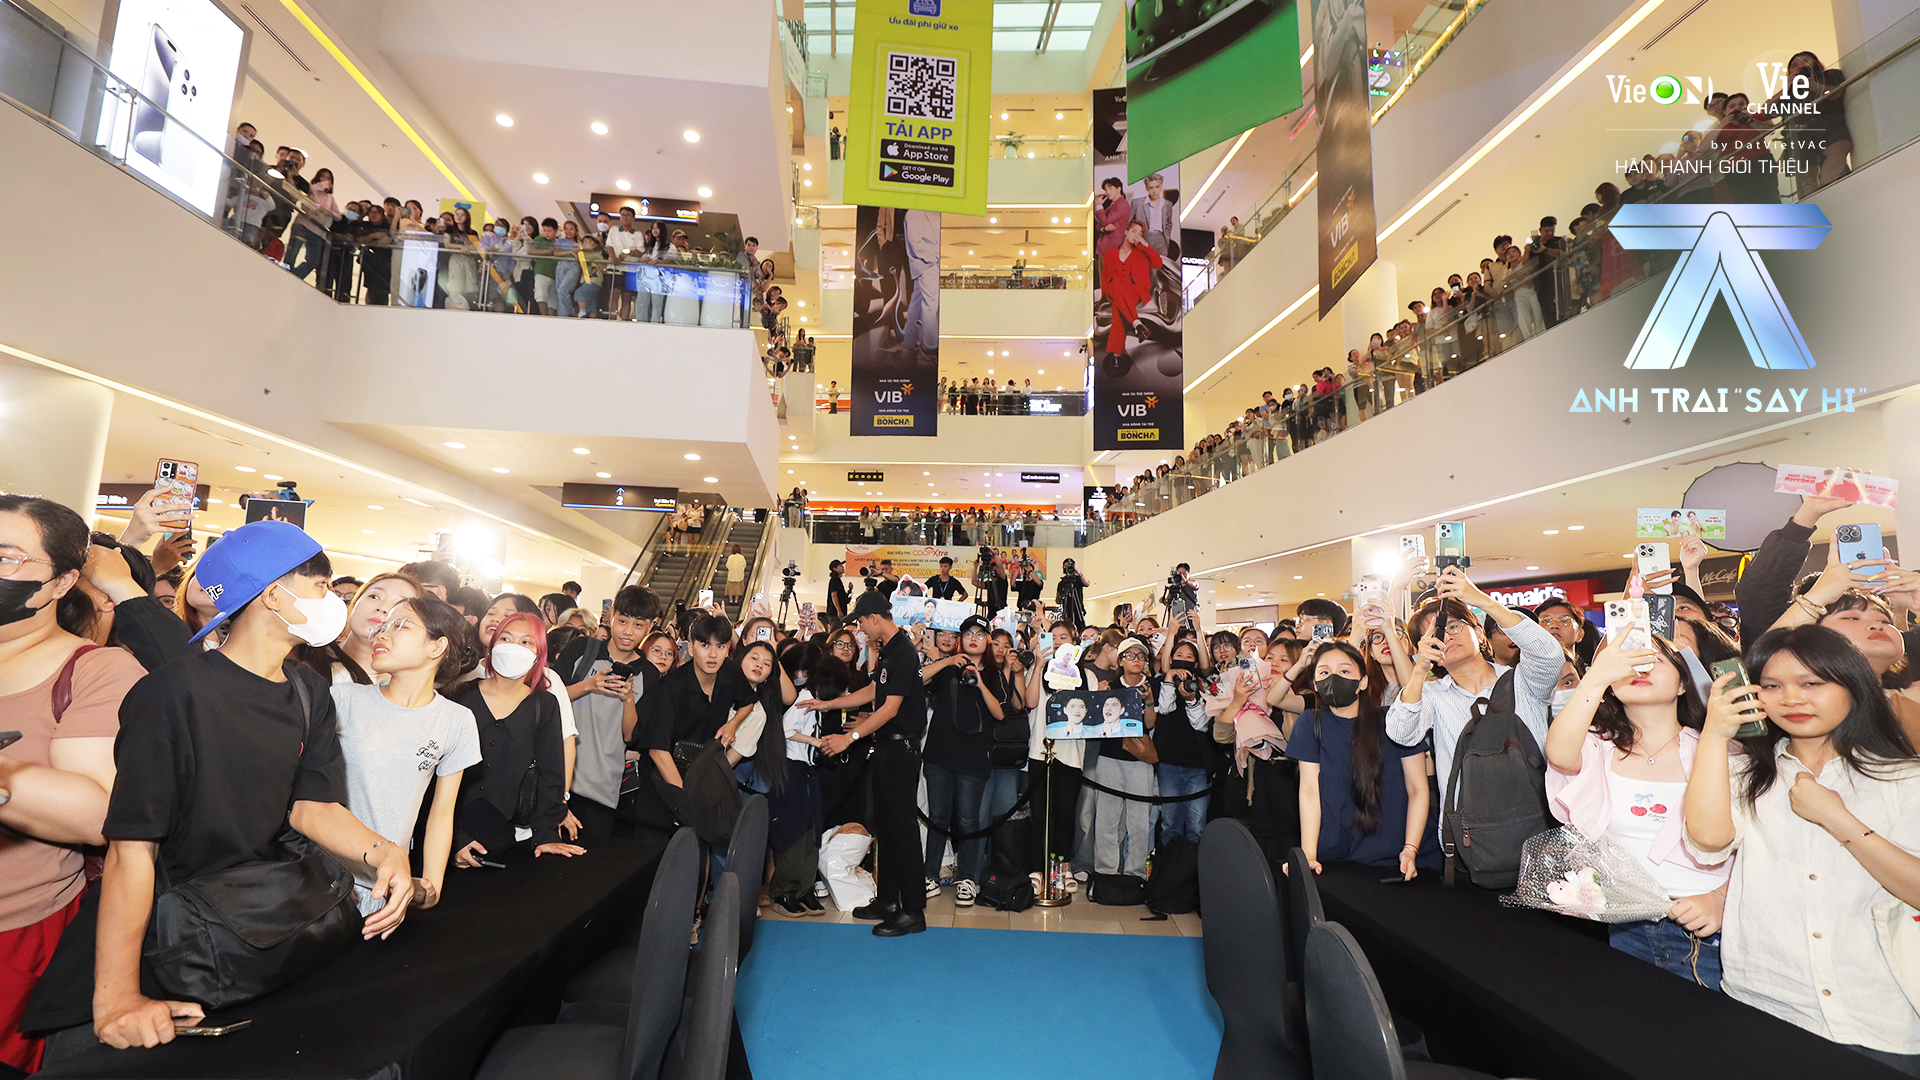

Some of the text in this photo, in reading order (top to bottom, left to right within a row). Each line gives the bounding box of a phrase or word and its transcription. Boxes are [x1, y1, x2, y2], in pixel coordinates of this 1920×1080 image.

[889, 16, 901, 25] Ưu
[918, 19, 931, 28] phí
[885, 119, 953, 140] TẢI APP
[904, 143, 930, 151] Download
[903, 149, 949, 162] App Store
[901, 171, 950, 185] Google Play
[1330, 212, 1350, 248] VIB
[874, 391, 903, 403] VIB
[1117, 404, 1147, 417] VIB
[616, 496, 624, 506] 2
[1490, 586, 1564, 606] Donald's
